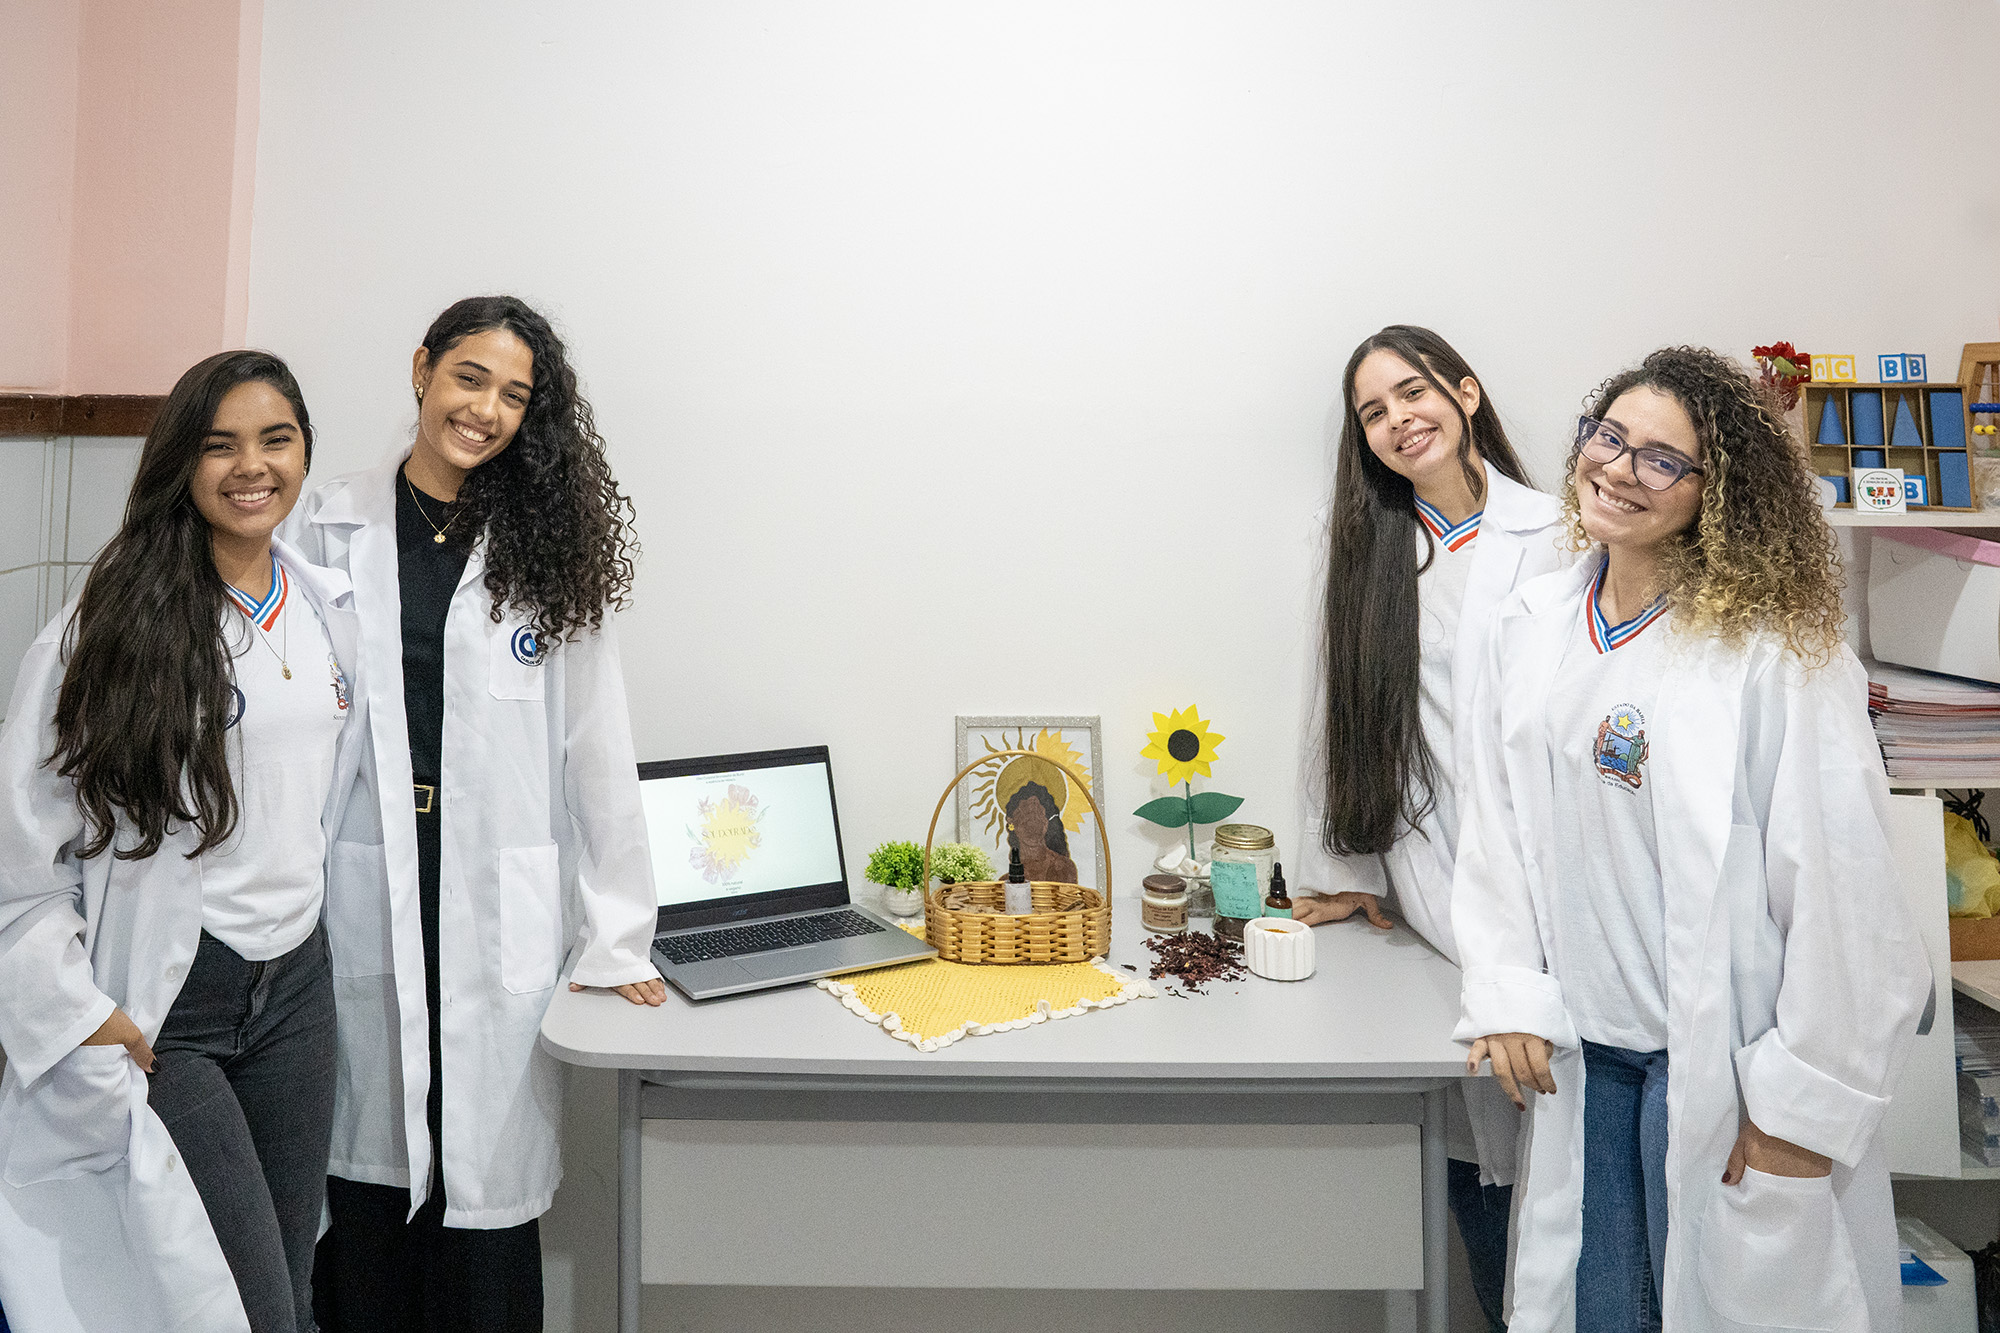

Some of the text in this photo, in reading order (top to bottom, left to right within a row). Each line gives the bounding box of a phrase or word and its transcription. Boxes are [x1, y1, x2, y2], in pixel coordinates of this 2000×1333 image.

[1834, 360, 1849, 378] C
[1884, 360, 1898, 377] B
[1909, 359, 1921, 377] B
[1905, 481, 1919, 499] B
